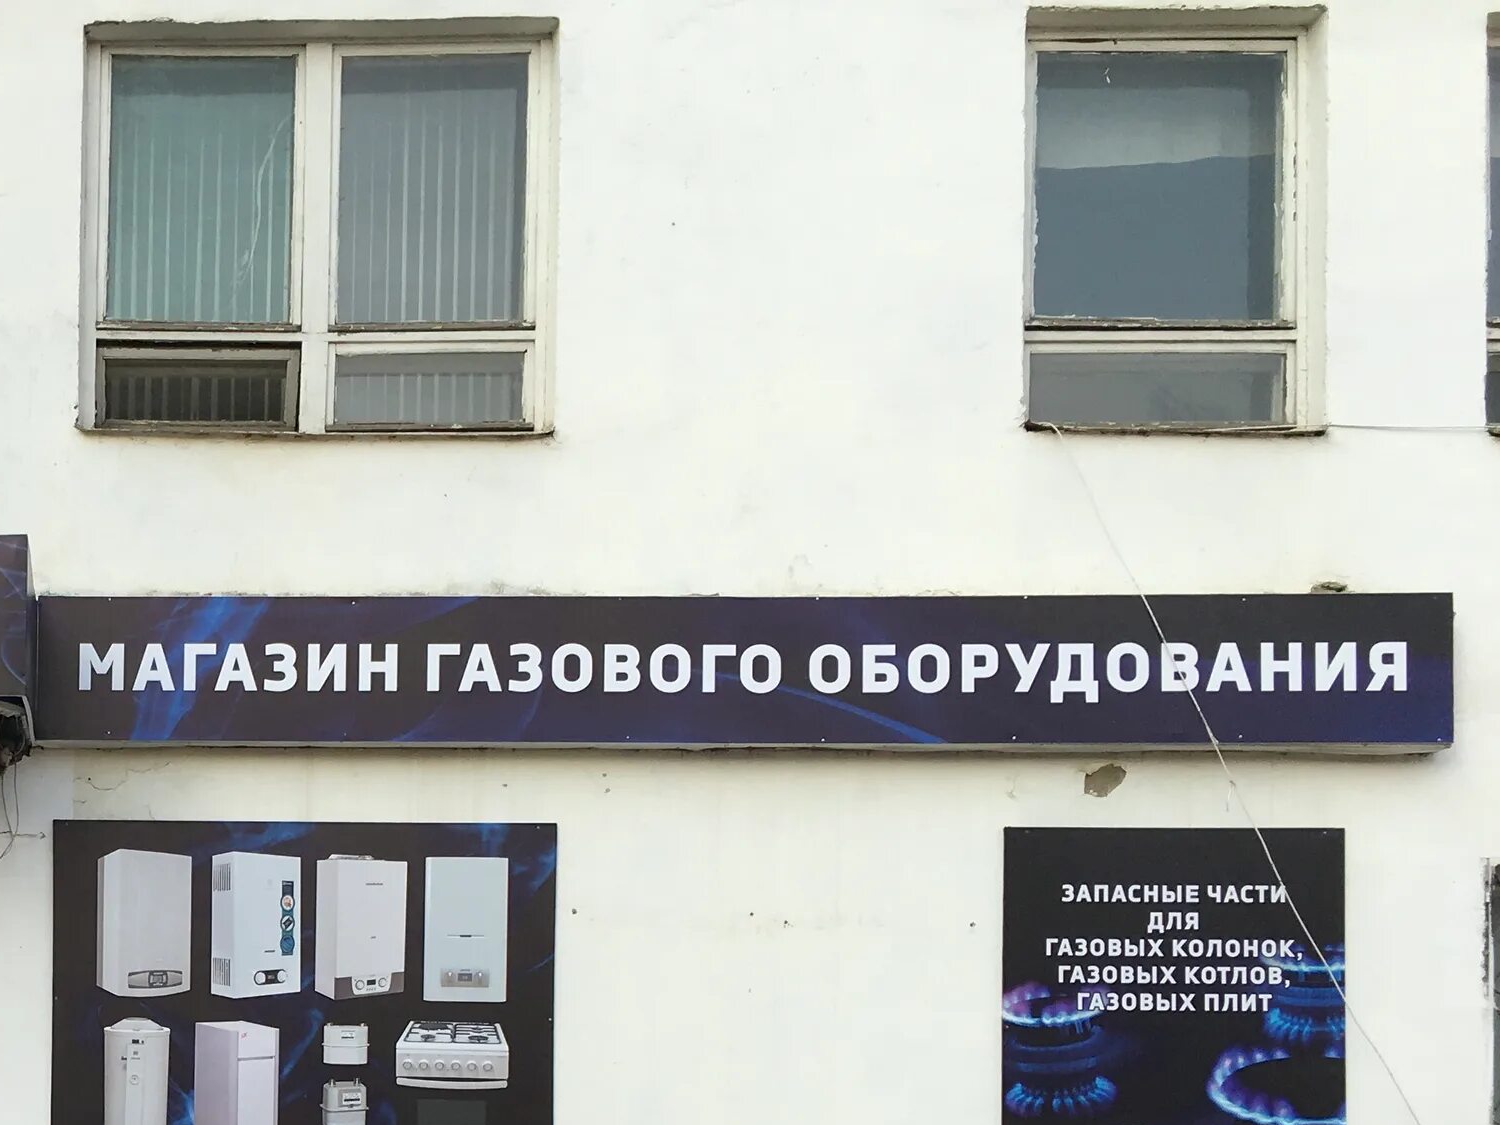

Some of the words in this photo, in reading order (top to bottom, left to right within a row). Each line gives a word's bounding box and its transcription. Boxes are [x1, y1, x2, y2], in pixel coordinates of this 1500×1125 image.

[78, 642, 399, 692] МАГАЗИН
[426, 642, 782, 694] ГАЗОВОГО
[808, 641, 1408, 704] ОБОРУДОВАНИЯ
[1061, 884, 1200, 903] ЗАПАСНЫЕ
[1207, 884, 1287, 904] ЧАСТИ
[1147, 911, 1200, 933] ДЛЯ
[1045, 938, 1164, 957] ГАЗОВЫХ
[1172, 938, 1304, 961] КОЛОНОК,
[1058, 965, 1177, 984] ГАЗОВЫХ
[1184, 965, 1291, 989] КОТЛОВ,
[1076, 992, 1196, 1012] ГАЗОВЫХ
[1204, 993, 1273, 1012] ПЛИТ
